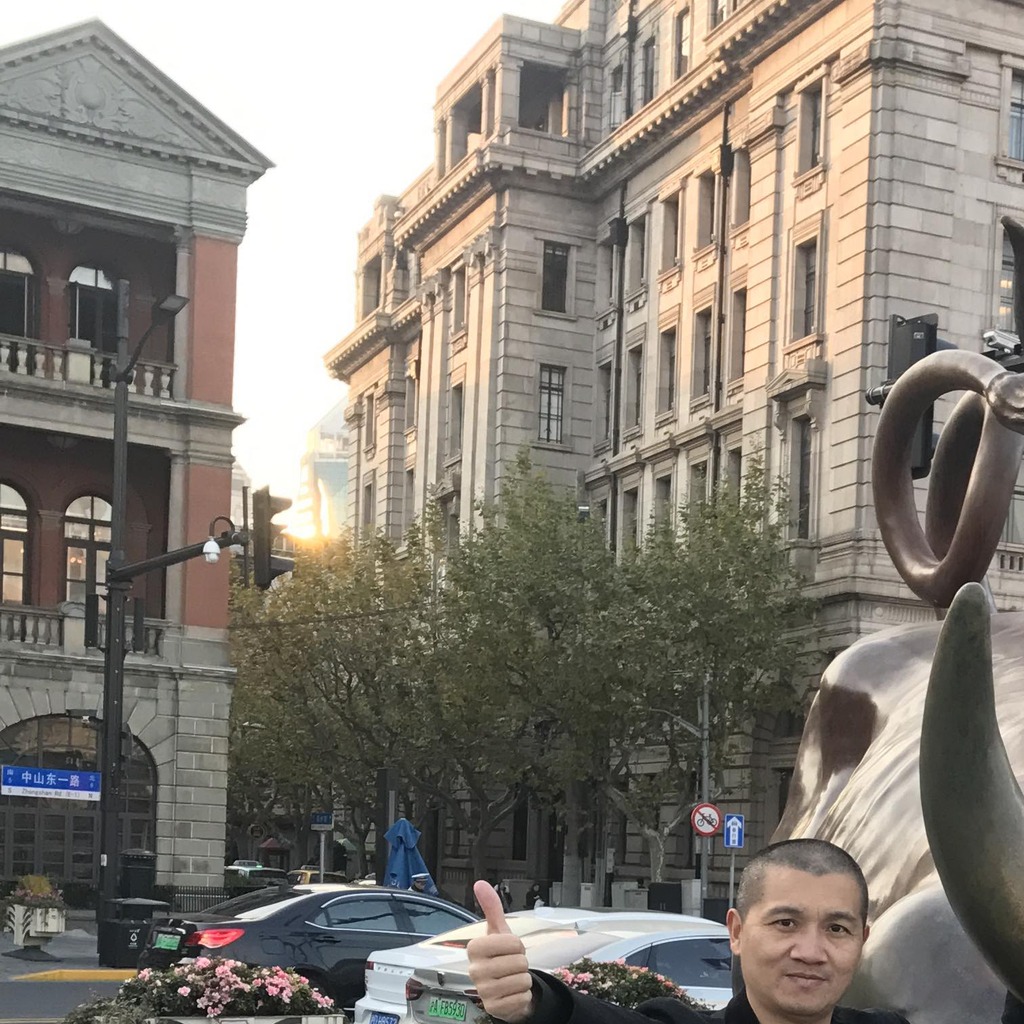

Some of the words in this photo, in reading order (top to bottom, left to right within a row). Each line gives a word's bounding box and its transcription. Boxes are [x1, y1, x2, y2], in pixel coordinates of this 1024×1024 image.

[21, 771, 80, 787] 中山东一路
